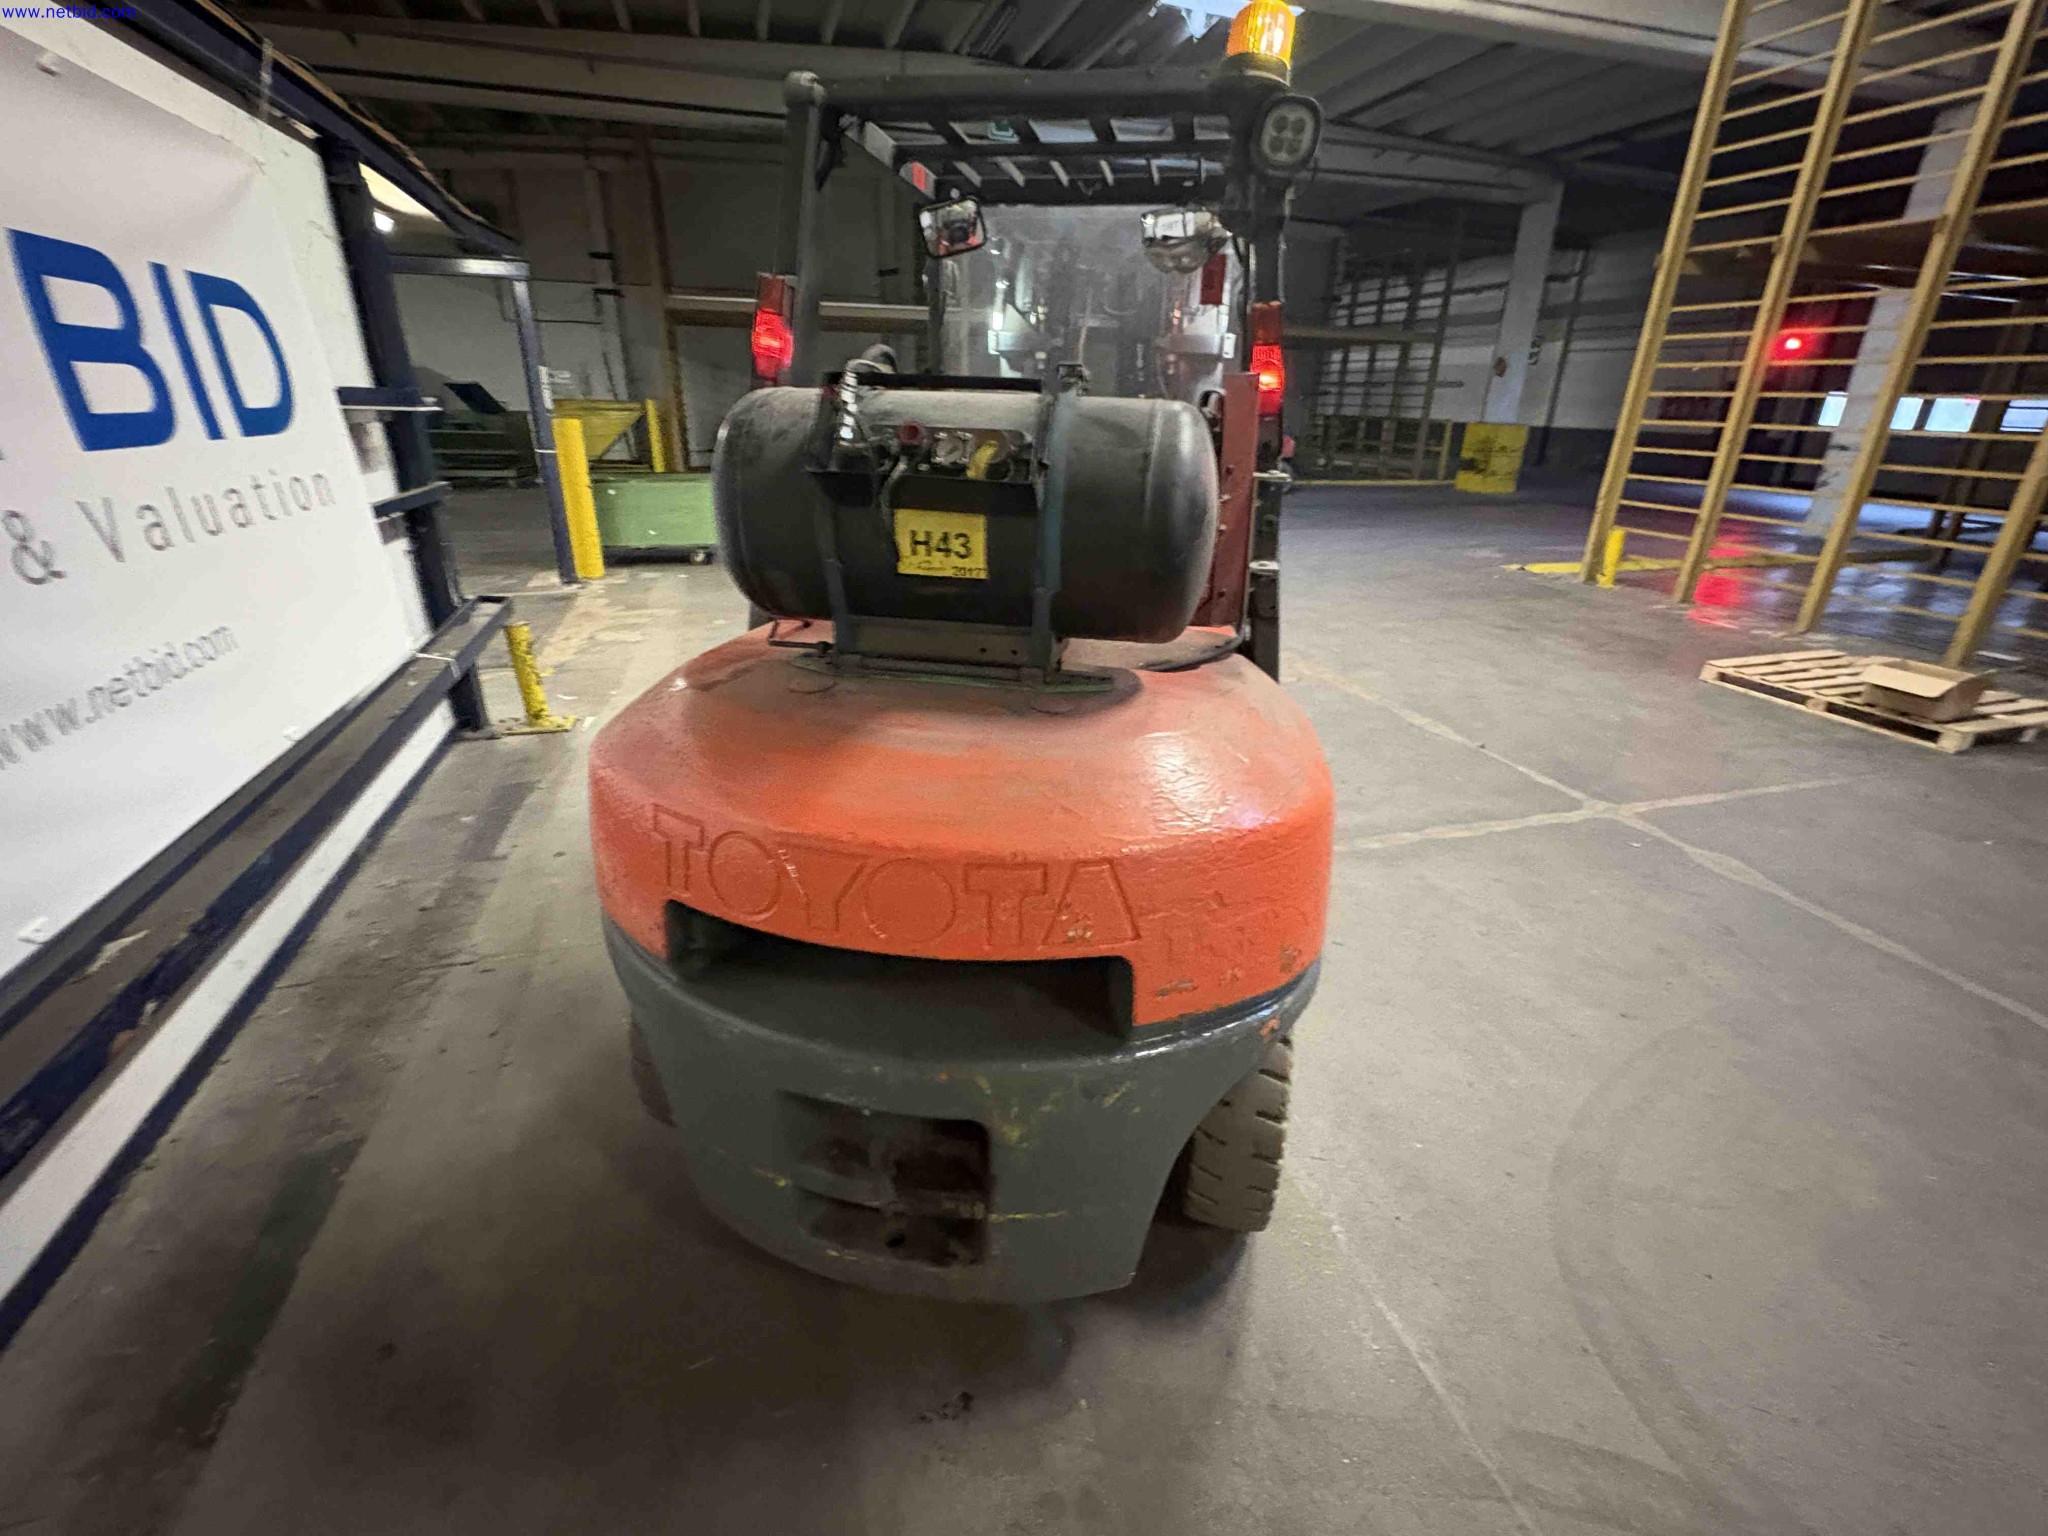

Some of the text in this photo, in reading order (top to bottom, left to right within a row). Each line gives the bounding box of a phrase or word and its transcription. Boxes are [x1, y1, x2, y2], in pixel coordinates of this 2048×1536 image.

[4, 227, 296, 452] BID
[1, 468, 337, 585] & Valuation
[910, 530, 971, 559] H43
[652, 803, 1141, 947] TOYOTA
